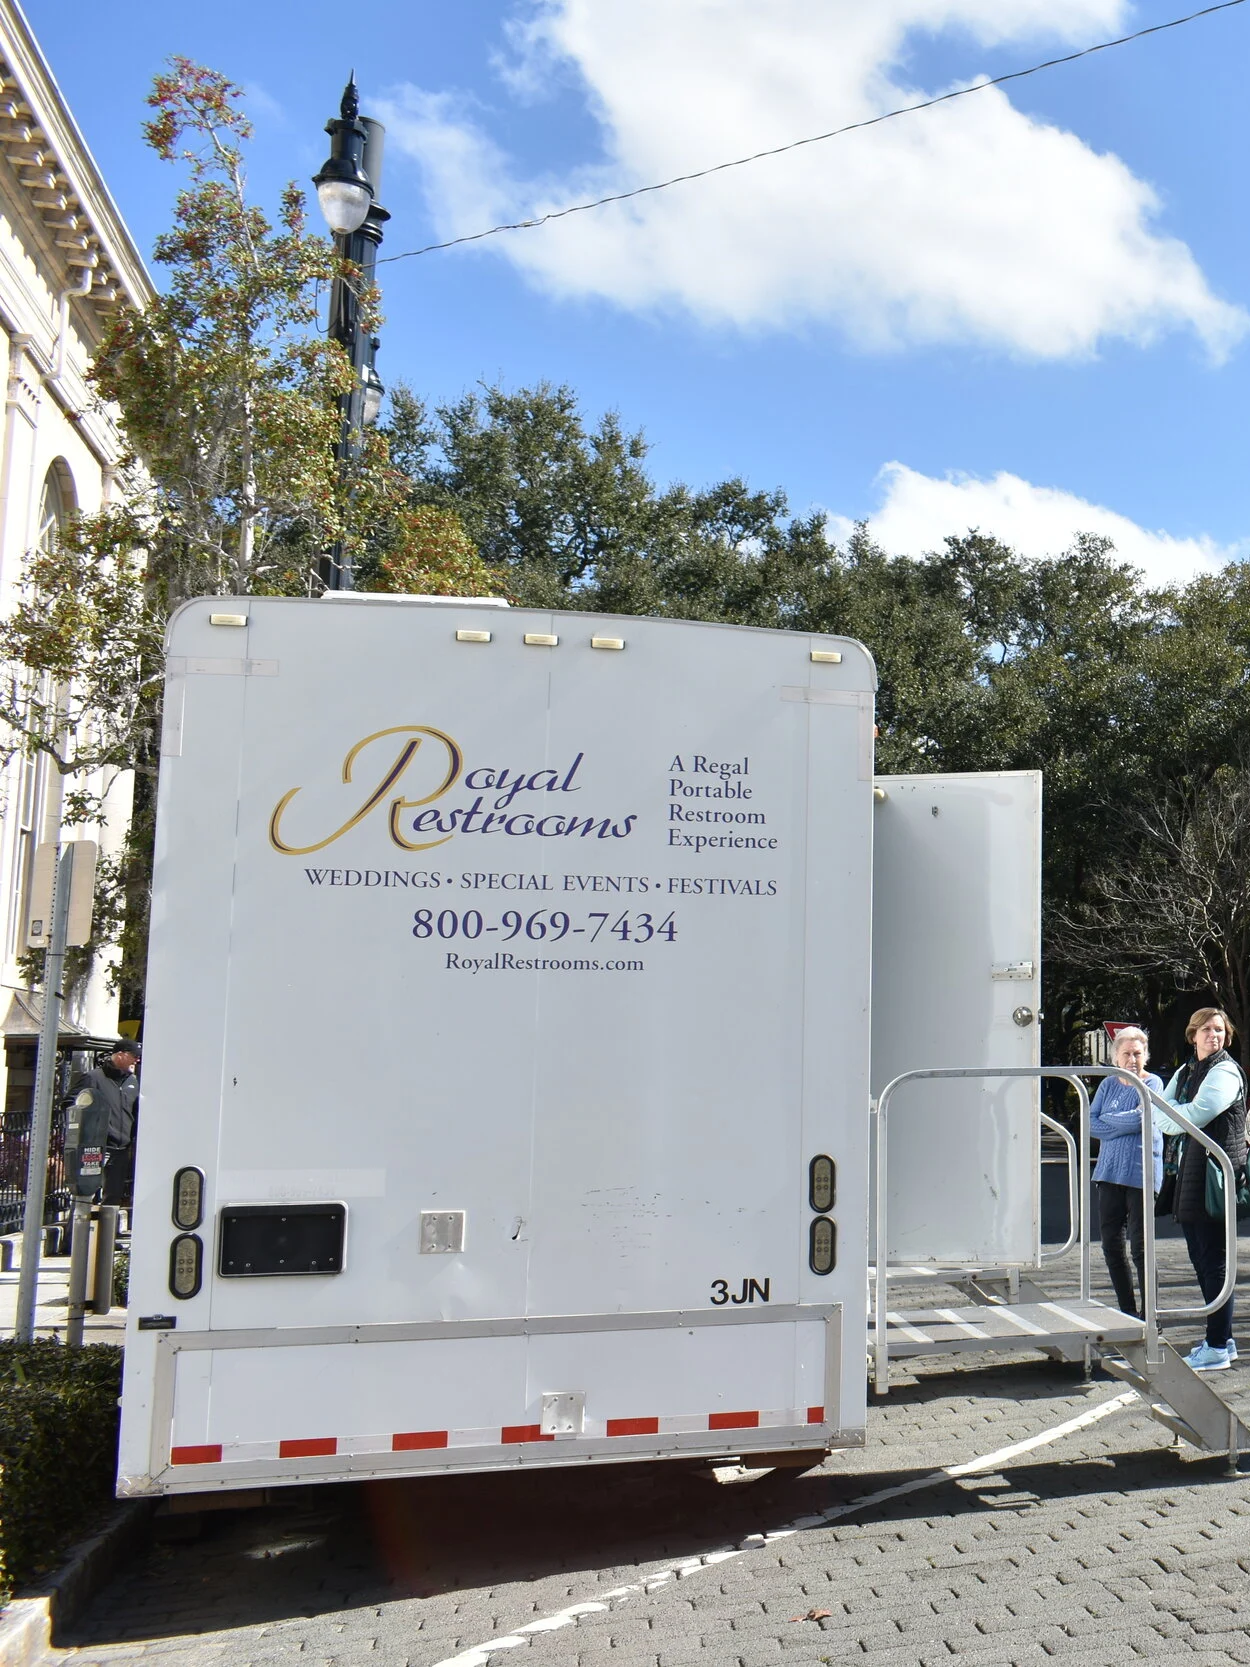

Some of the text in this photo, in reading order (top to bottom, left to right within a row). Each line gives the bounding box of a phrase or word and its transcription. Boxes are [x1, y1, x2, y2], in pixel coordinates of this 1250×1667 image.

[669, 755, 749, 780] A Regal
[669, 777, 752, 800] Portable
[669, 803, 767, 825] Restroom
[667, 828, 778, 853] Experience
[304, 868, 777, 896] WEDDINGS SPECIAL EVENTS FESTIVALS
[412, 908, 679, 943] 800-969-7434
[446, 952, 645, 975] RoyalRestrooms.com
[710, 1277, 769, 1305] 3JN
